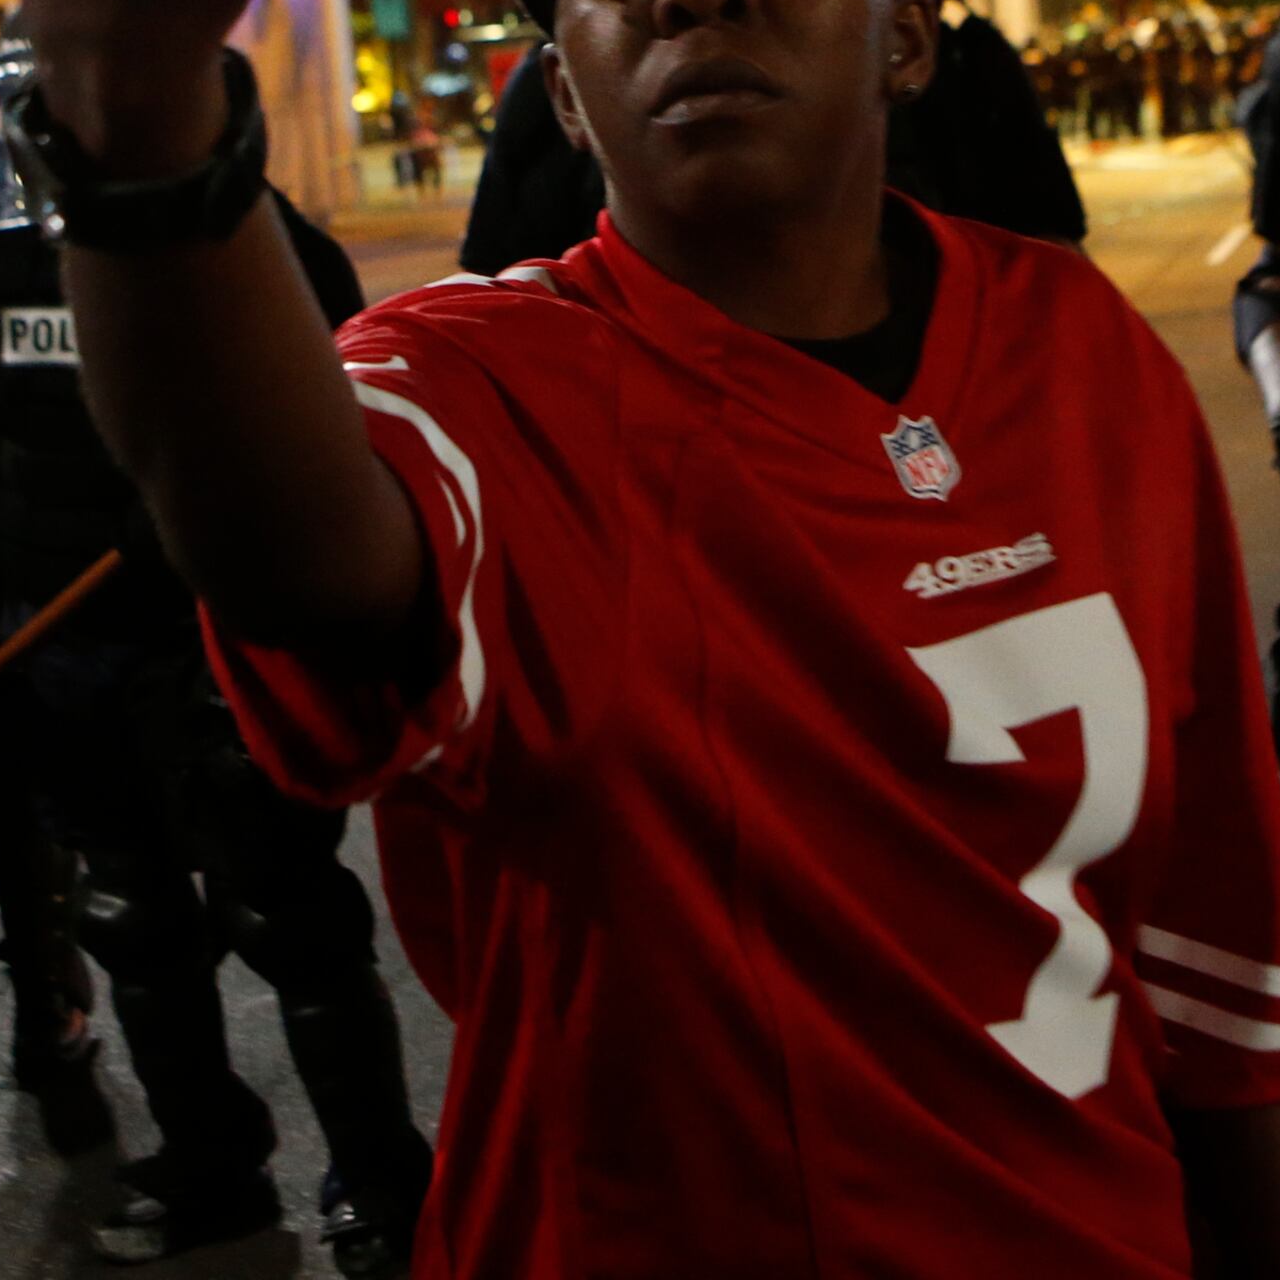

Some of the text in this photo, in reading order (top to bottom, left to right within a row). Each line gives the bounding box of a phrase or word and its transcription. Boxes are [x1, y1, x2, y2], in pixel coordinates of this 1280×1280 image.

[9, 318, 76, 355] POL
[902, 532, 1057, 599] 49ERS
[904, 591, 1149, 1101] 7
